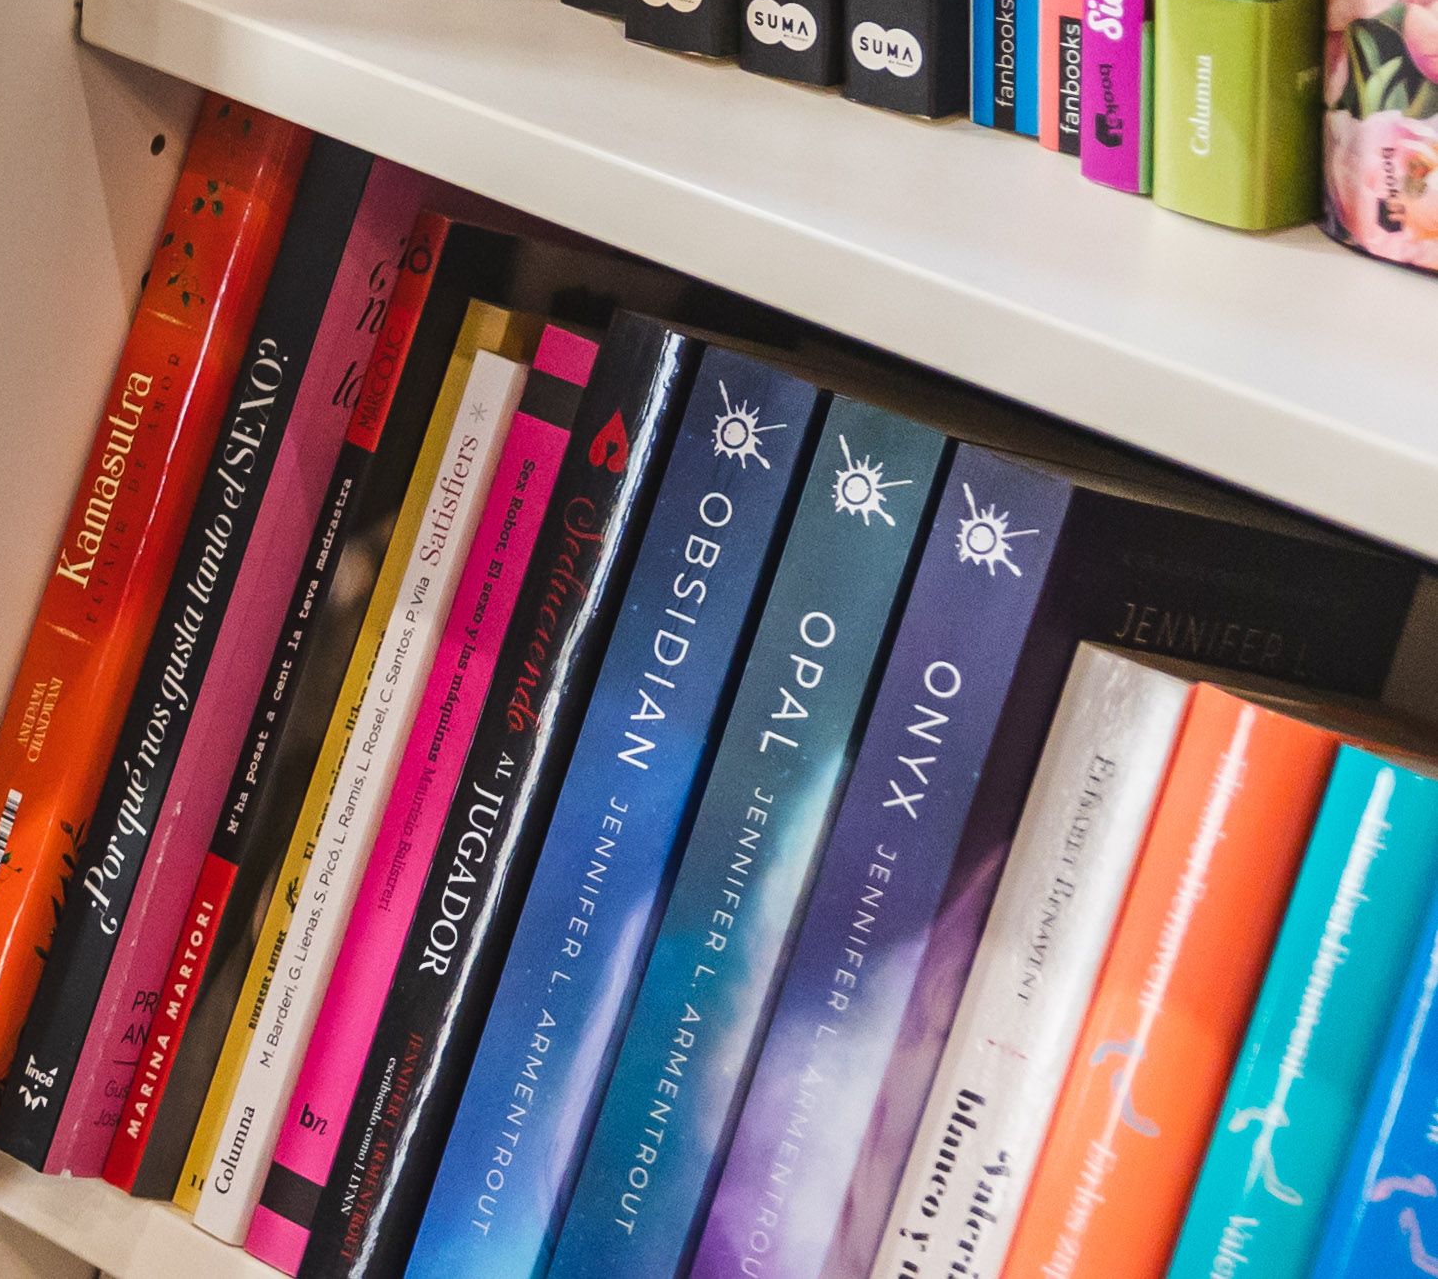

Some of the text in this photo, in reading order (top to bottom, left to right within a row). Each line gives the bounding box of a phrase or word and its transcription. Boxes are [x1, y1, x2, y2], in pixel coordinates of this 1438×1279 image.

[753, 10, 809, 36] SUMA
[859, 35, 916, 63] SUMA
[1061, 23, 1080, 136] fanbooks
[1191, 54, 1212, 157] Columna
[56, 371, 154, 589] Kamasutra
[418, 434, 480, 569] Satisfiers
[84, 338, 289, 937] ¿Por qué nos gusta tanto SEXO?
[246, 477, 352, 784] posat cent teva madrastra
[424, 457, 537, 768] Sex sexo las máquinas
[266, 625, 413, 1050] Barderi, Lienas, Ramis, Rosel, Santos,
[494, 750, 515, 780] AL
[825, 660, 962, 1013] ONYX JENNIFER
[419, 780, 504, 975] JUGADOR
[470, 492, 733, 1237] OBSIDIAN JENNIFER ARMENTROUT
[614, 611, 837, 1237] OPAL JENNIFER ARMENTROUT
[126, 1034, 171, 1139] MARINA
[166, 901, 215, 1020] MARTORI
[214, 1105, 256, 1195] Columna
[341, 1057, 396, 1216] escribiendo como LYNN
[921, 1088, 986, 1218] blanco
